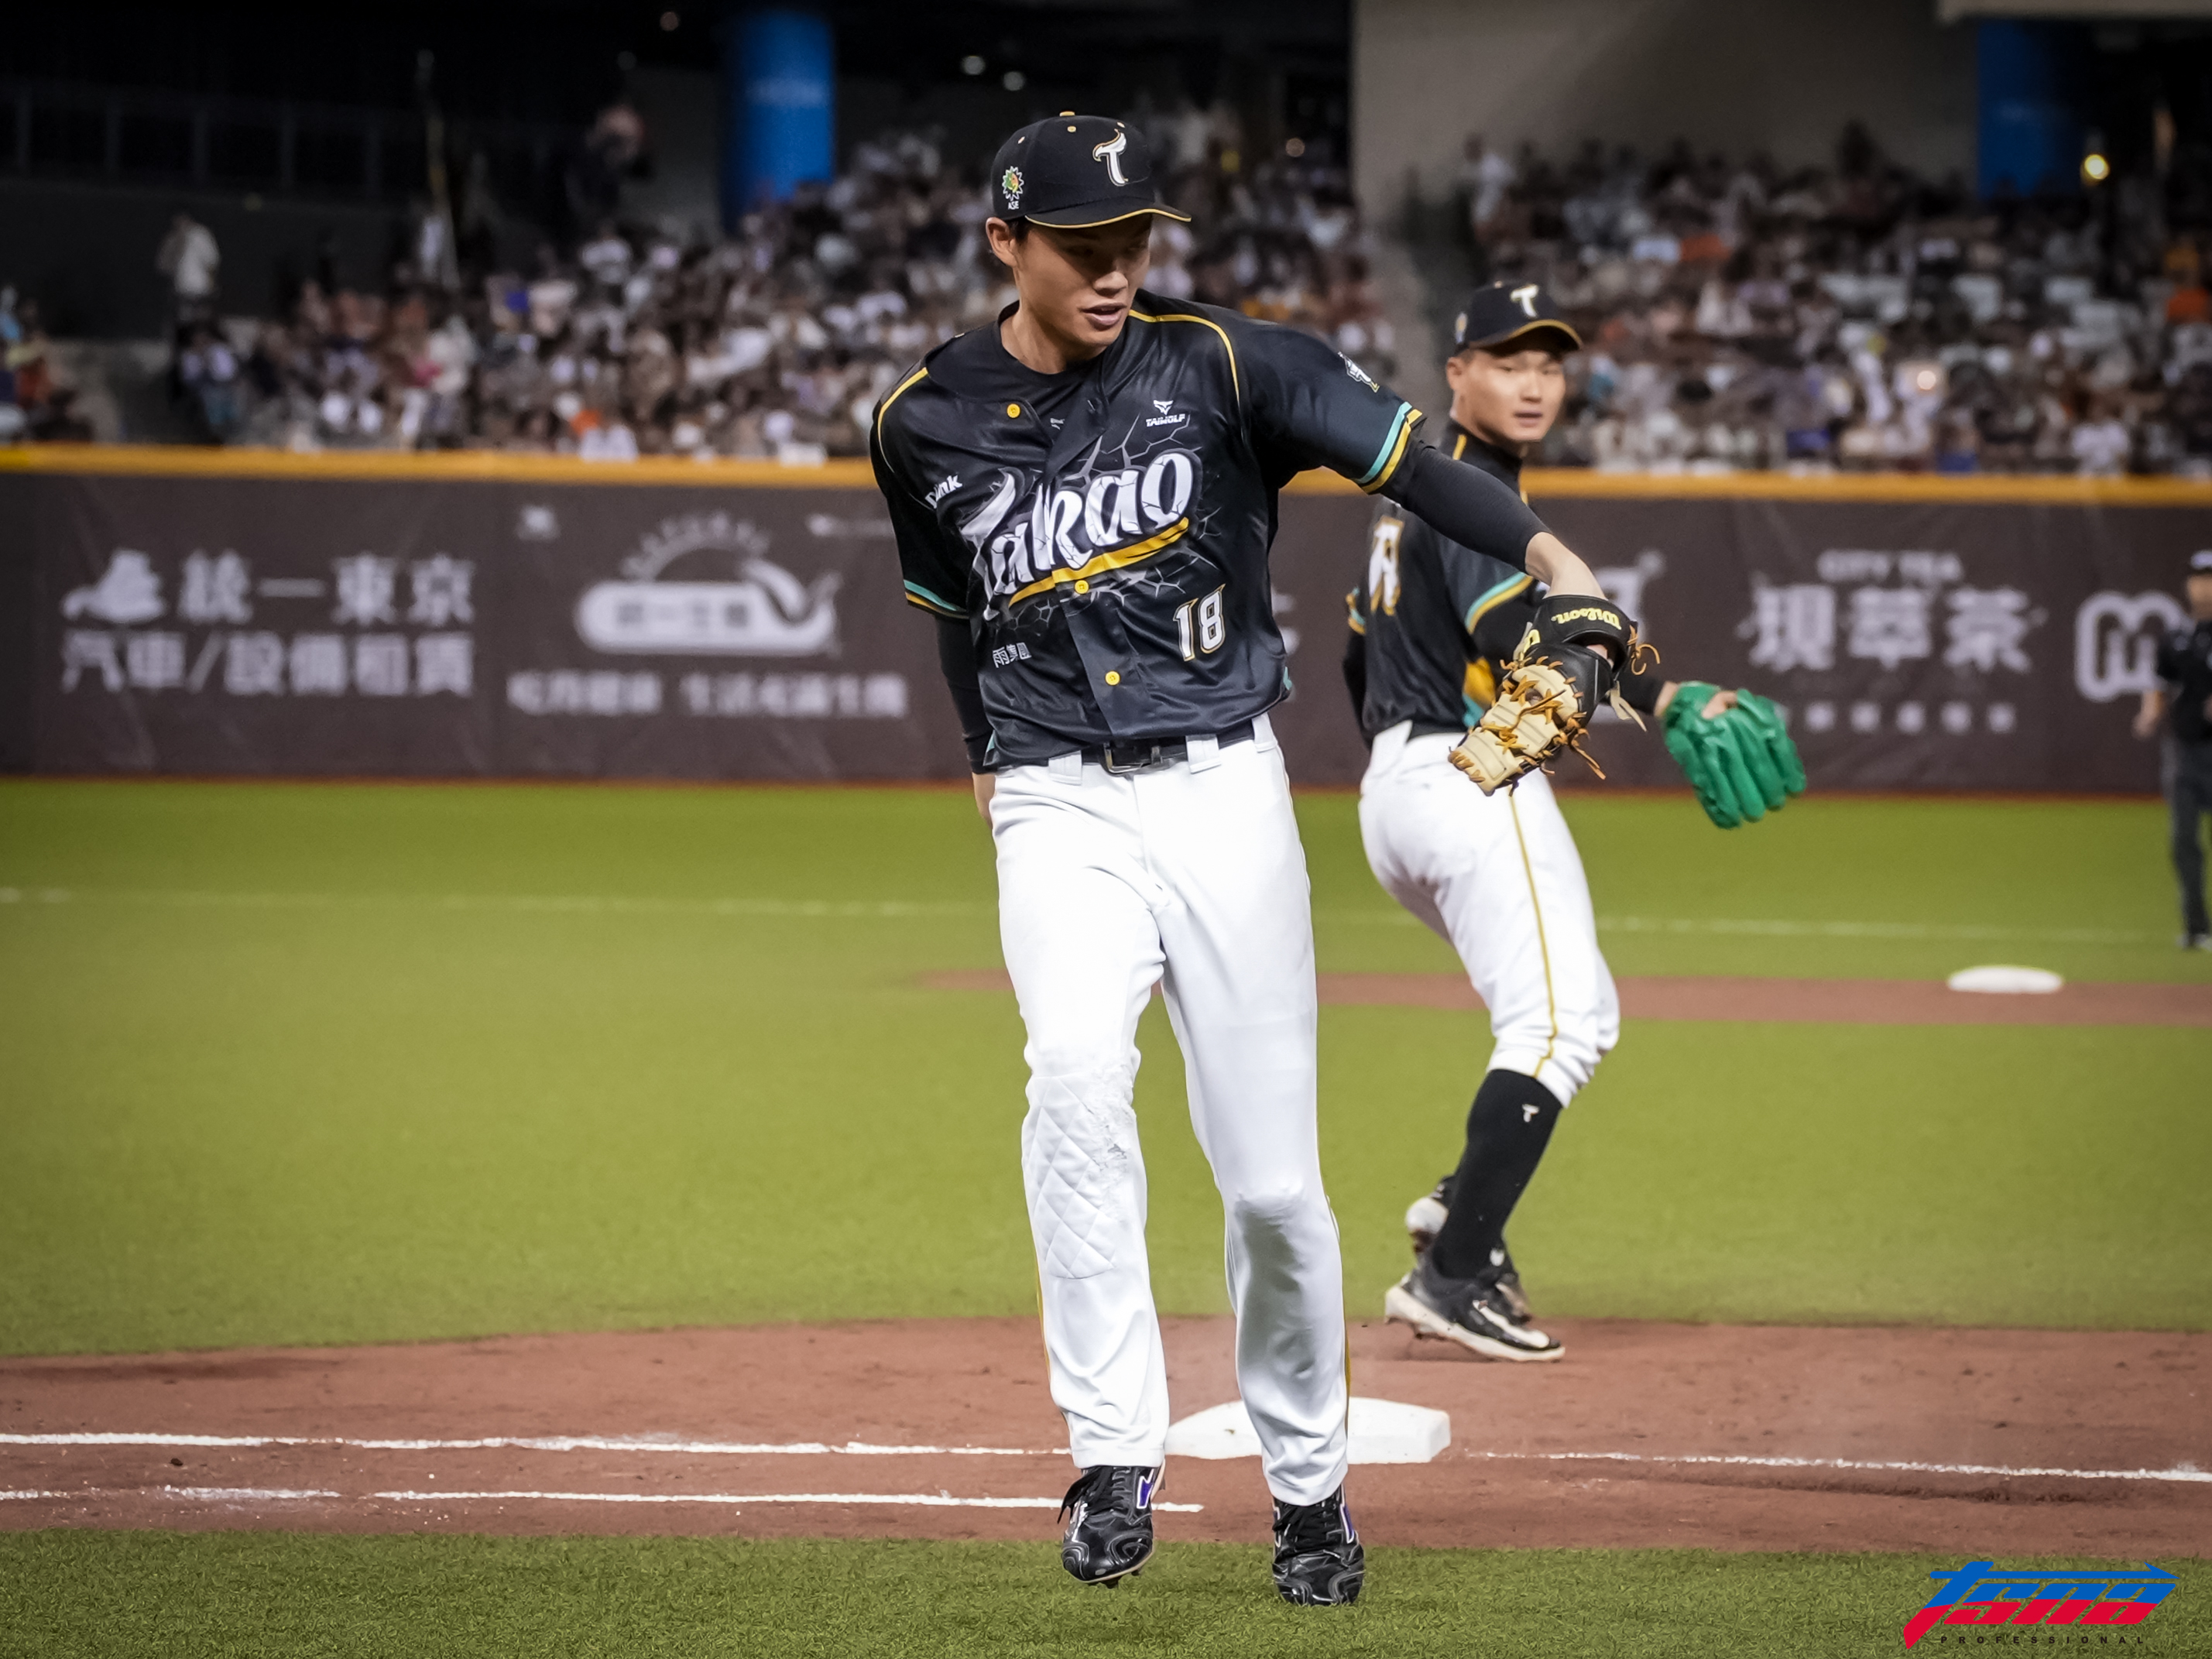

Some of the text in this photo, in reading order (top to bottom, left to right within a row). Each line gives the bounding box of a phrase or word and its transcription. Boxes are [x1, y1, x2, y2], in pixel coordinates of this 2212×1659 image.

[1008, 201, 1020, 210] ASE
[959, 452, 1193, 621] Takao
[1173, 583, 1226, 662] 18
